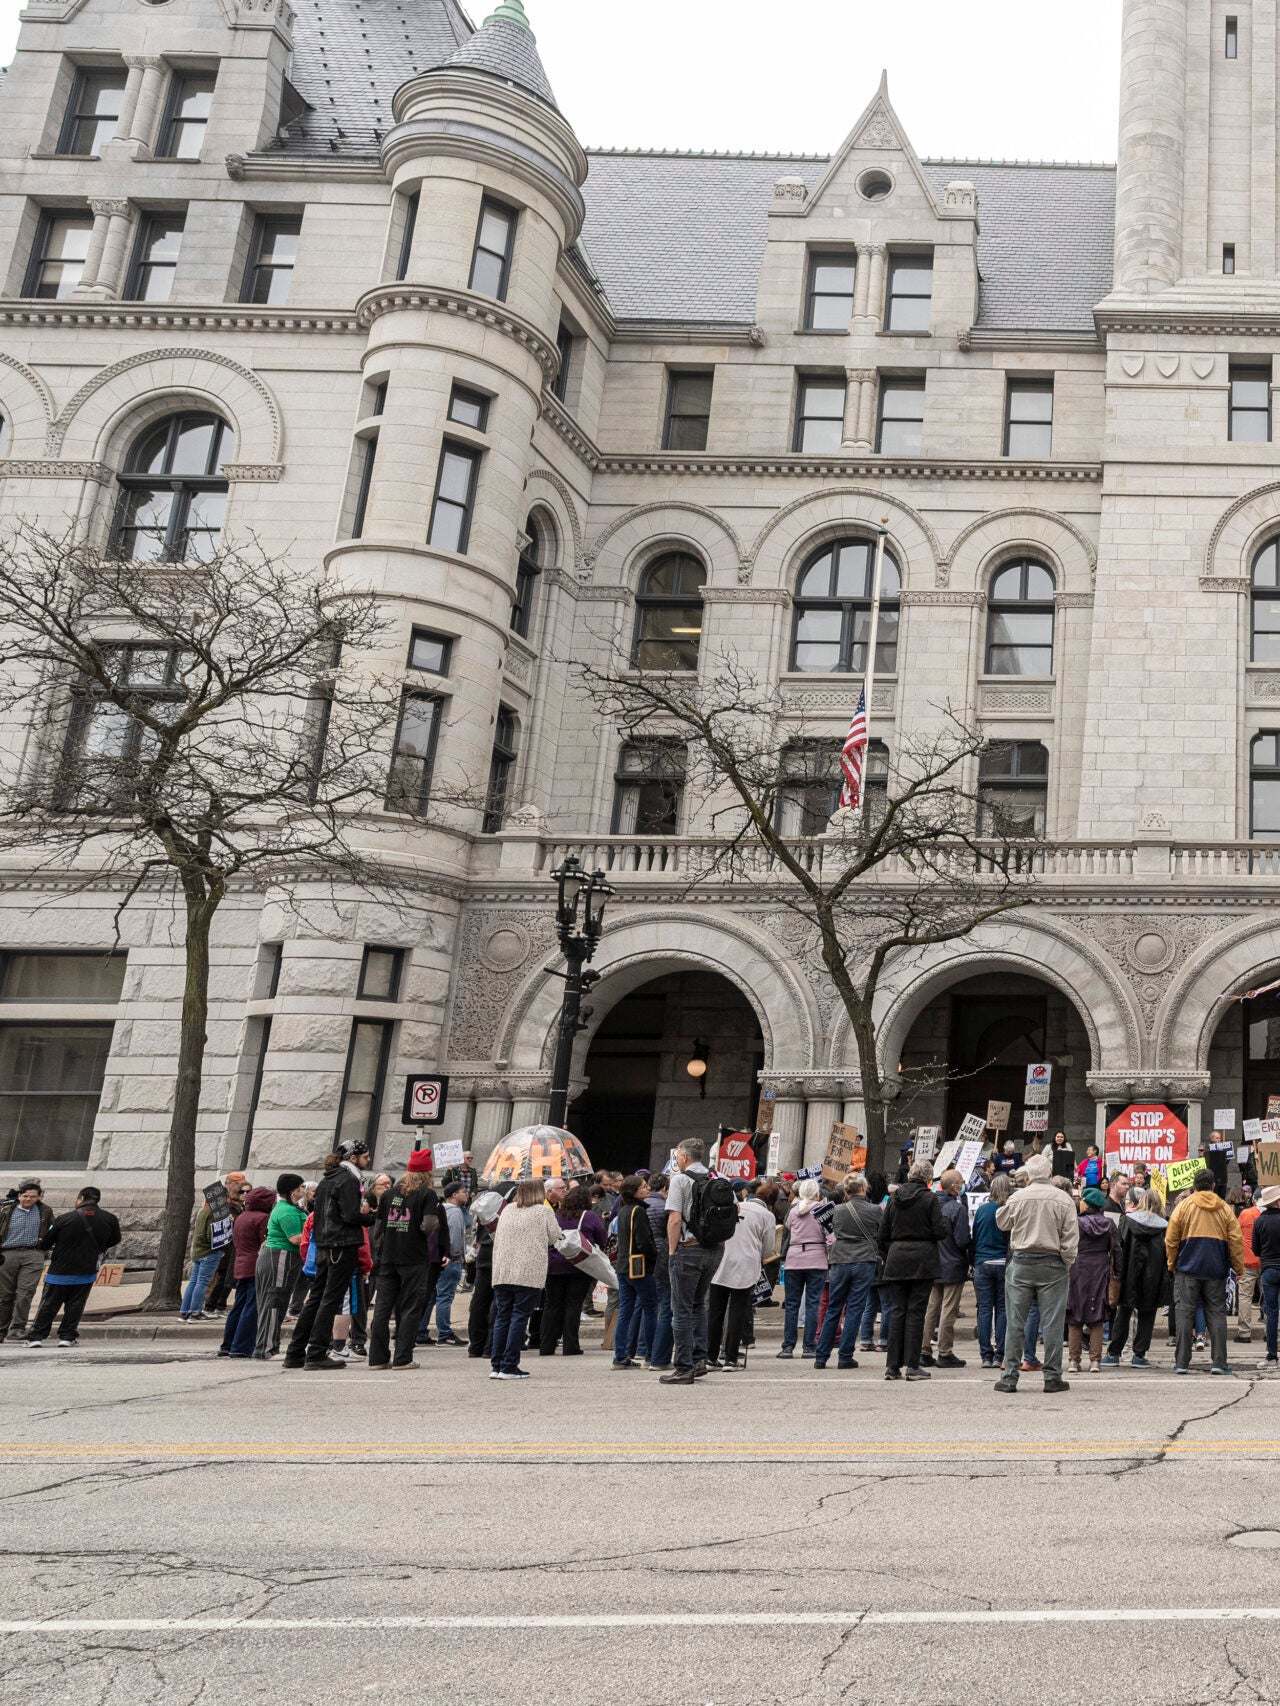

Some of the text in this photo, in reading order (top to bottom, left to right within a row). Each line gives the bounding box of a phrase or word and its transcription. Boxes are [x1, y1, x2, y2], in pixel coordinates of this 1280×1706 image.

[968, 1117, 983, 1128] FREE
[1130, 1112, 1164, 1127] STOP
[833, 1125, 845, 1135] DUE
[961, 1126, 980, 1137] JUDGE
[1118, 1129, 1175, 1144] TRUMP'S
[831, 1134, 854, 1150] PROCESS
[831, 1145, 844, 1157] FOR
[1120, 1146, 1172, 1161] WAR ON
